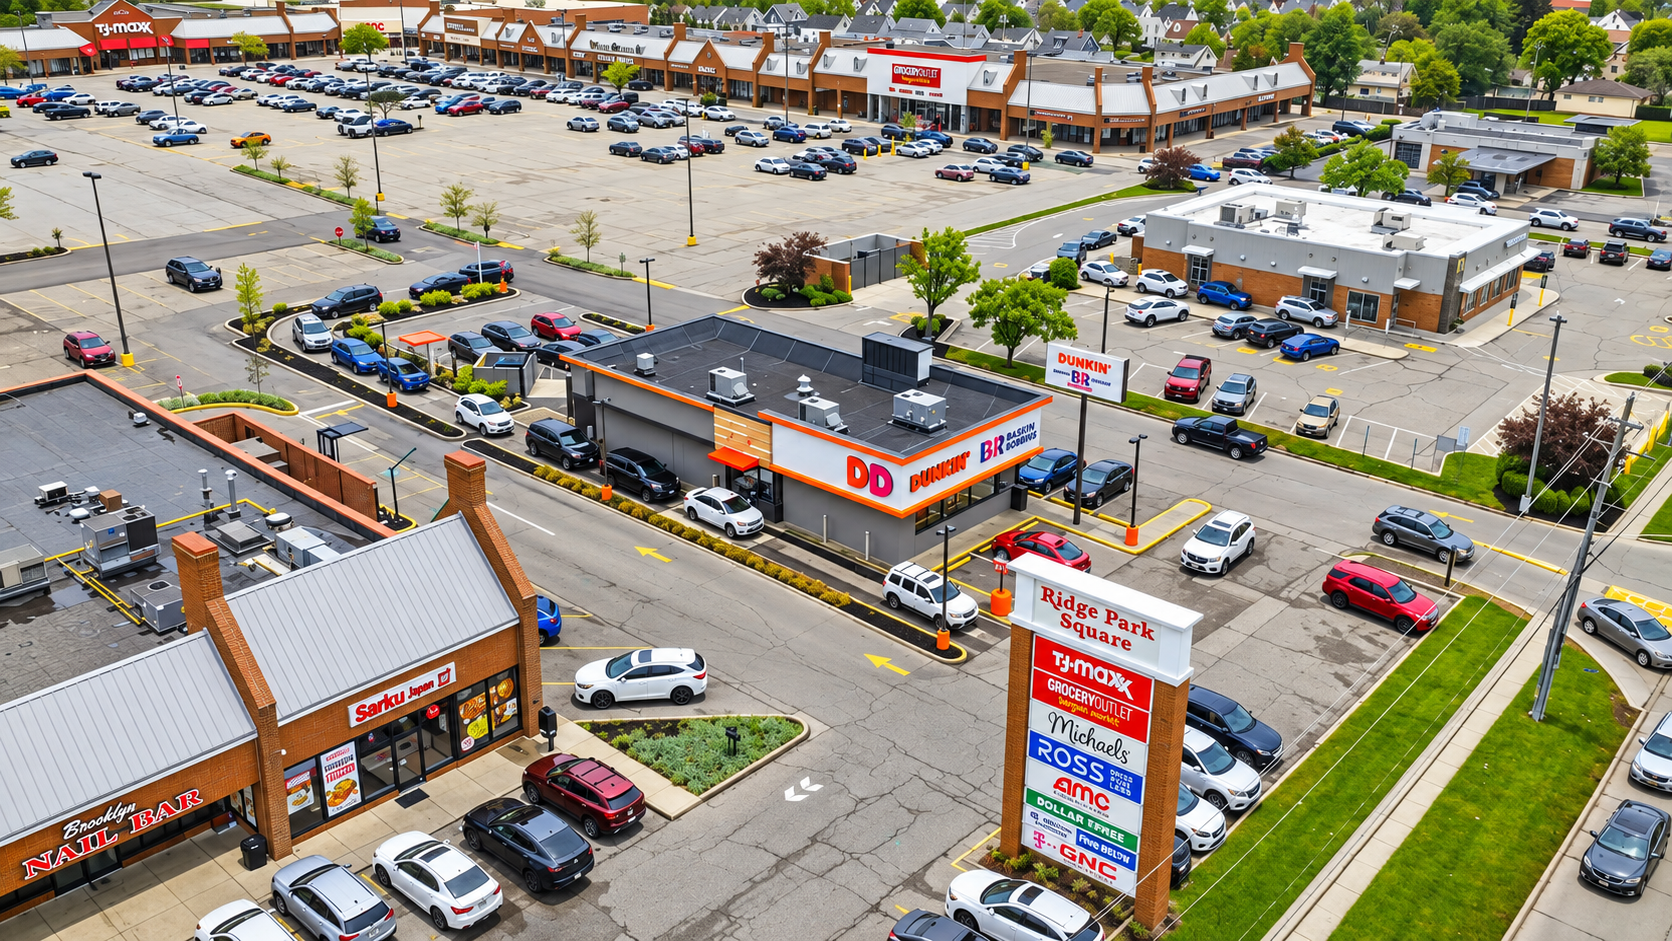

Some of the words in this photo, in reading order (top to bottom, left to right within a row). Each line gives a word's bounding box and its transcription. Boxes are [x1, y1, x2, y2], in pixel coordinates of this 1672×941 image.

[1071, 370, 1090, 386] BR
[980, 435, 1005, 463] BR
[1040, 585, 1098, 620] Ridge
[1104, 608, 1155, 641] Park
[1060, 612, 1132, 651] Square
[355, 691, 405, 722] Sarku
[408, 680, 435, 699] Japan
[1038, 738, 1104, 783] ROSS
[63, 802, 137, 840] Brooklyn
[1037, 796, 1084, 825] DOLLAR
[22, 827, 119, 880] NAIL
[128, 788, 204, 834] BAR
[1060, 843, 1117, 881] GNC
